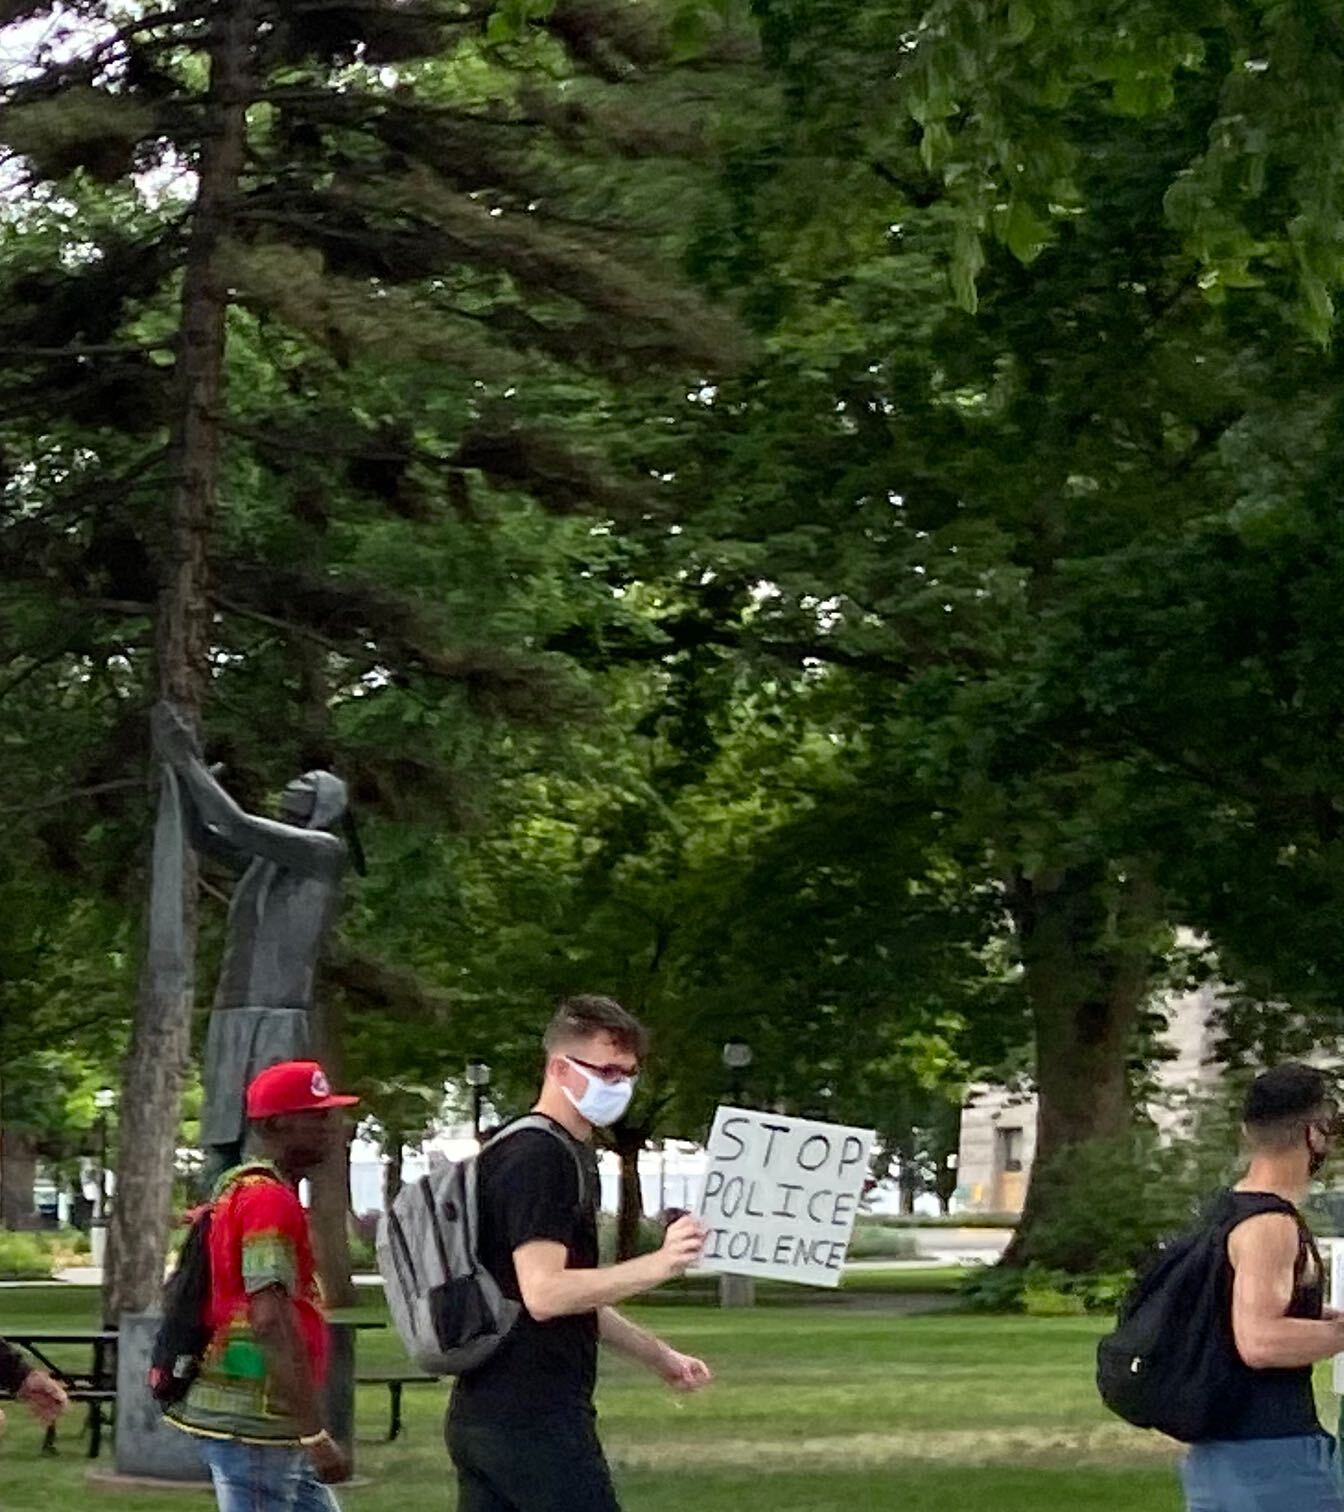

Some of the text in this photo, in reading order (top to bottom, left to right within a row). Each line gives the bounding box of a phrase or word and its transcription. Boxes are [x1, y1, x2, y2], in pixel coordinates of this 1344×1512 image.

[715, 1118, 863, 1178] STOP
[700, 1171, 856, 1226] POLICE
[703, 1229, 846, 1270] IOLENCE
